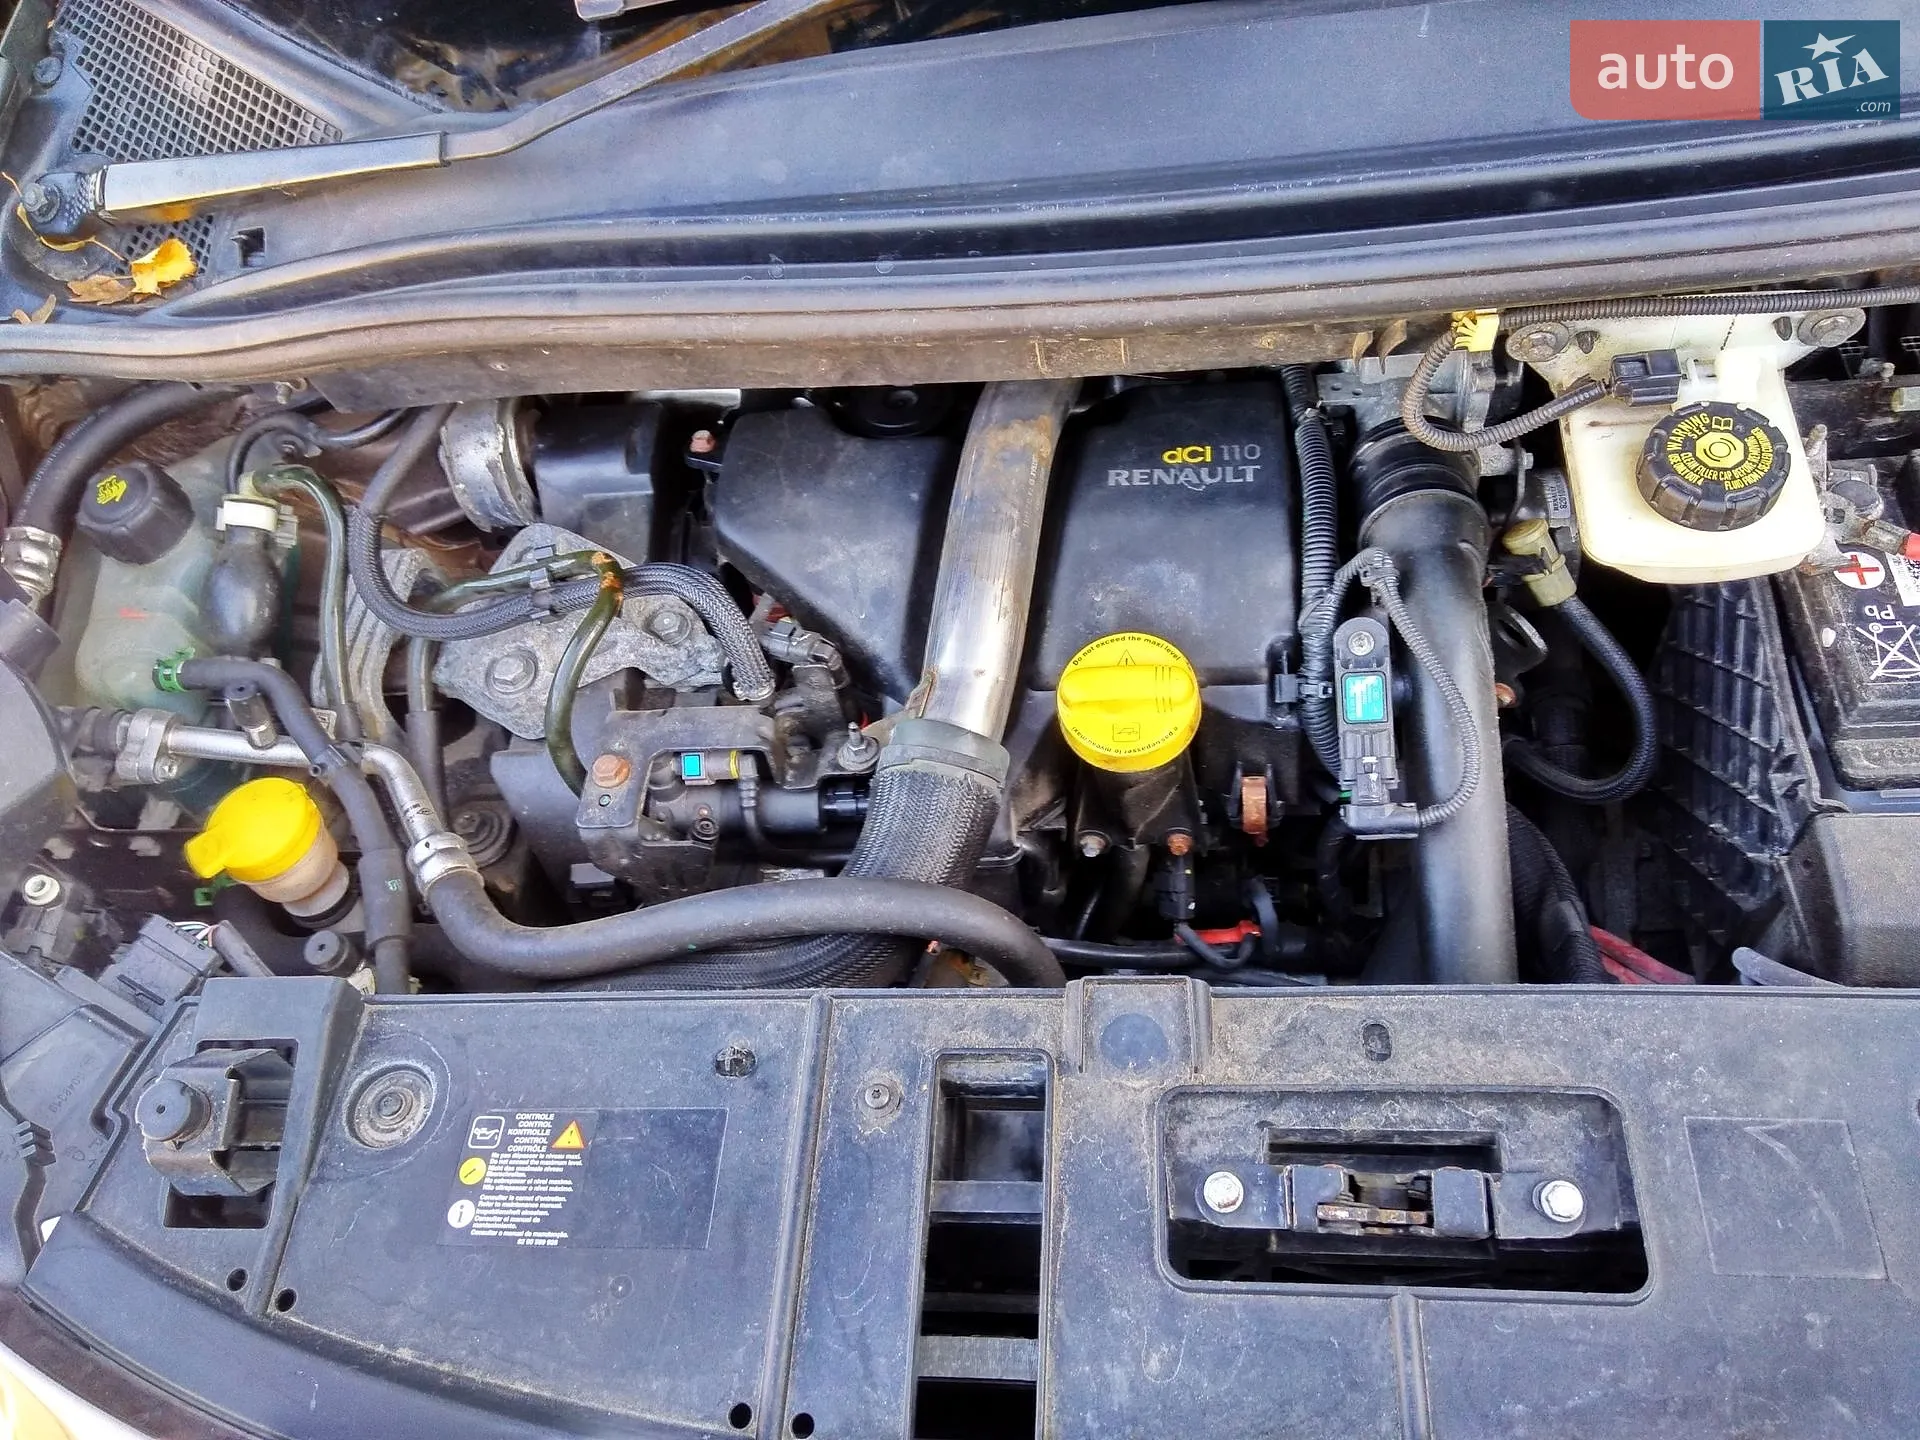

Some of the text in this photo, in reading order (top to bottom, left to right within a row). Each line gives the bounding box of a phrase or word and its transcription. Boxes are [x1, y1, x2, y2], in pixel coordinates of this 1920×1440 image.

[1666, 412, 1711, 451] WARNING
[1688, 424, 1709, 440] SEE
[1219, 444, 1261, 460] 110
[1107, 465, 1262, 491] RENAULT
[1695, 464, 1718, 480] FILLER
[1719, 470, 1733, 481] CAP
[1724, 478, 1745, 491] FLUID
[1744, 472, 1761, 486] FROM
[1864, 604, 1896, 620] Pb
[1072, 656, 1083, 666] Do
[1083, 646, 1095, 657] not
[1096, 636, 1126, 649] exceed
[1144, 637, 1164, 648] maxi
[1164, 643, 1181, 661] level
[507, 1128, 551, 1136] KONTROLLE
[513, 1136, 549, 1144] CONTROL
